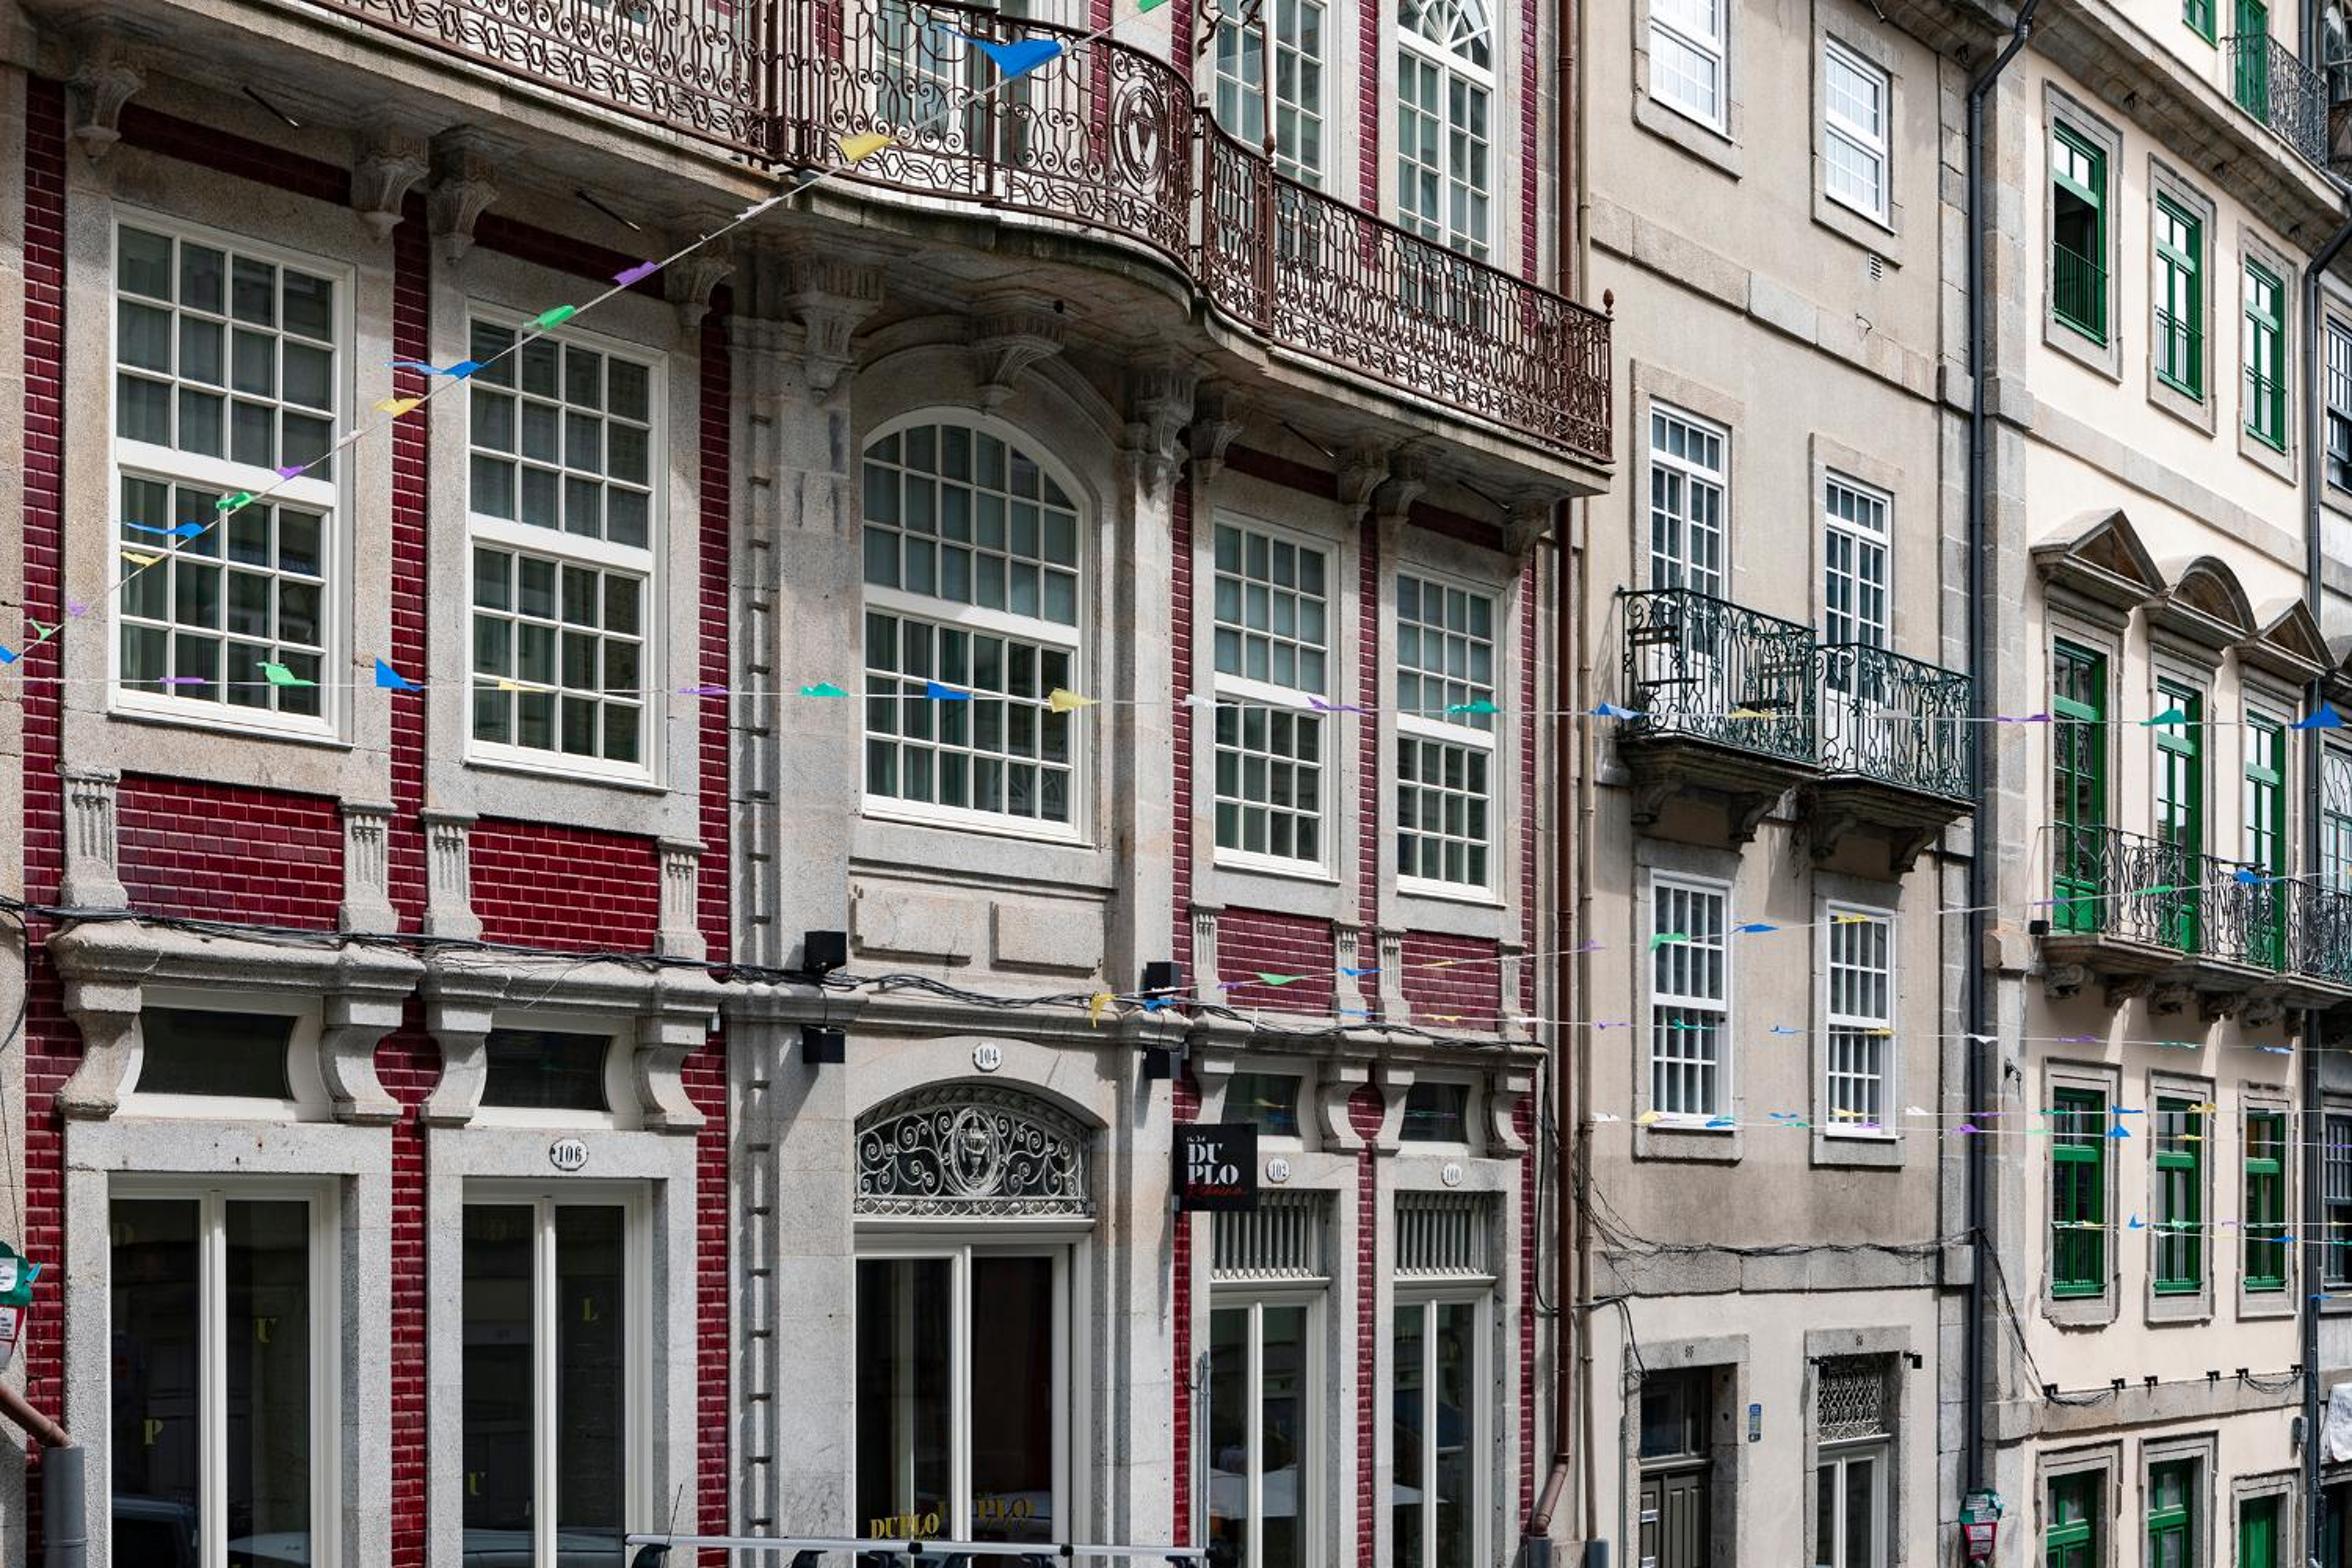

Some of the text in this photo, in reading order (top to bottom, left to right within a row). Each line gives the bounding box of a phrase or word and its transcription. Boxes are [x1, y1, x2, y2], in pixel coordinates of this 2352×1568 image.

[980, 1048, 998, 1064] 104
[560, 1145, 583, 1162] 106
[1187, 1164, 1240, 1185] PLO
[870, 1512, 940, 1539] DUPLO
